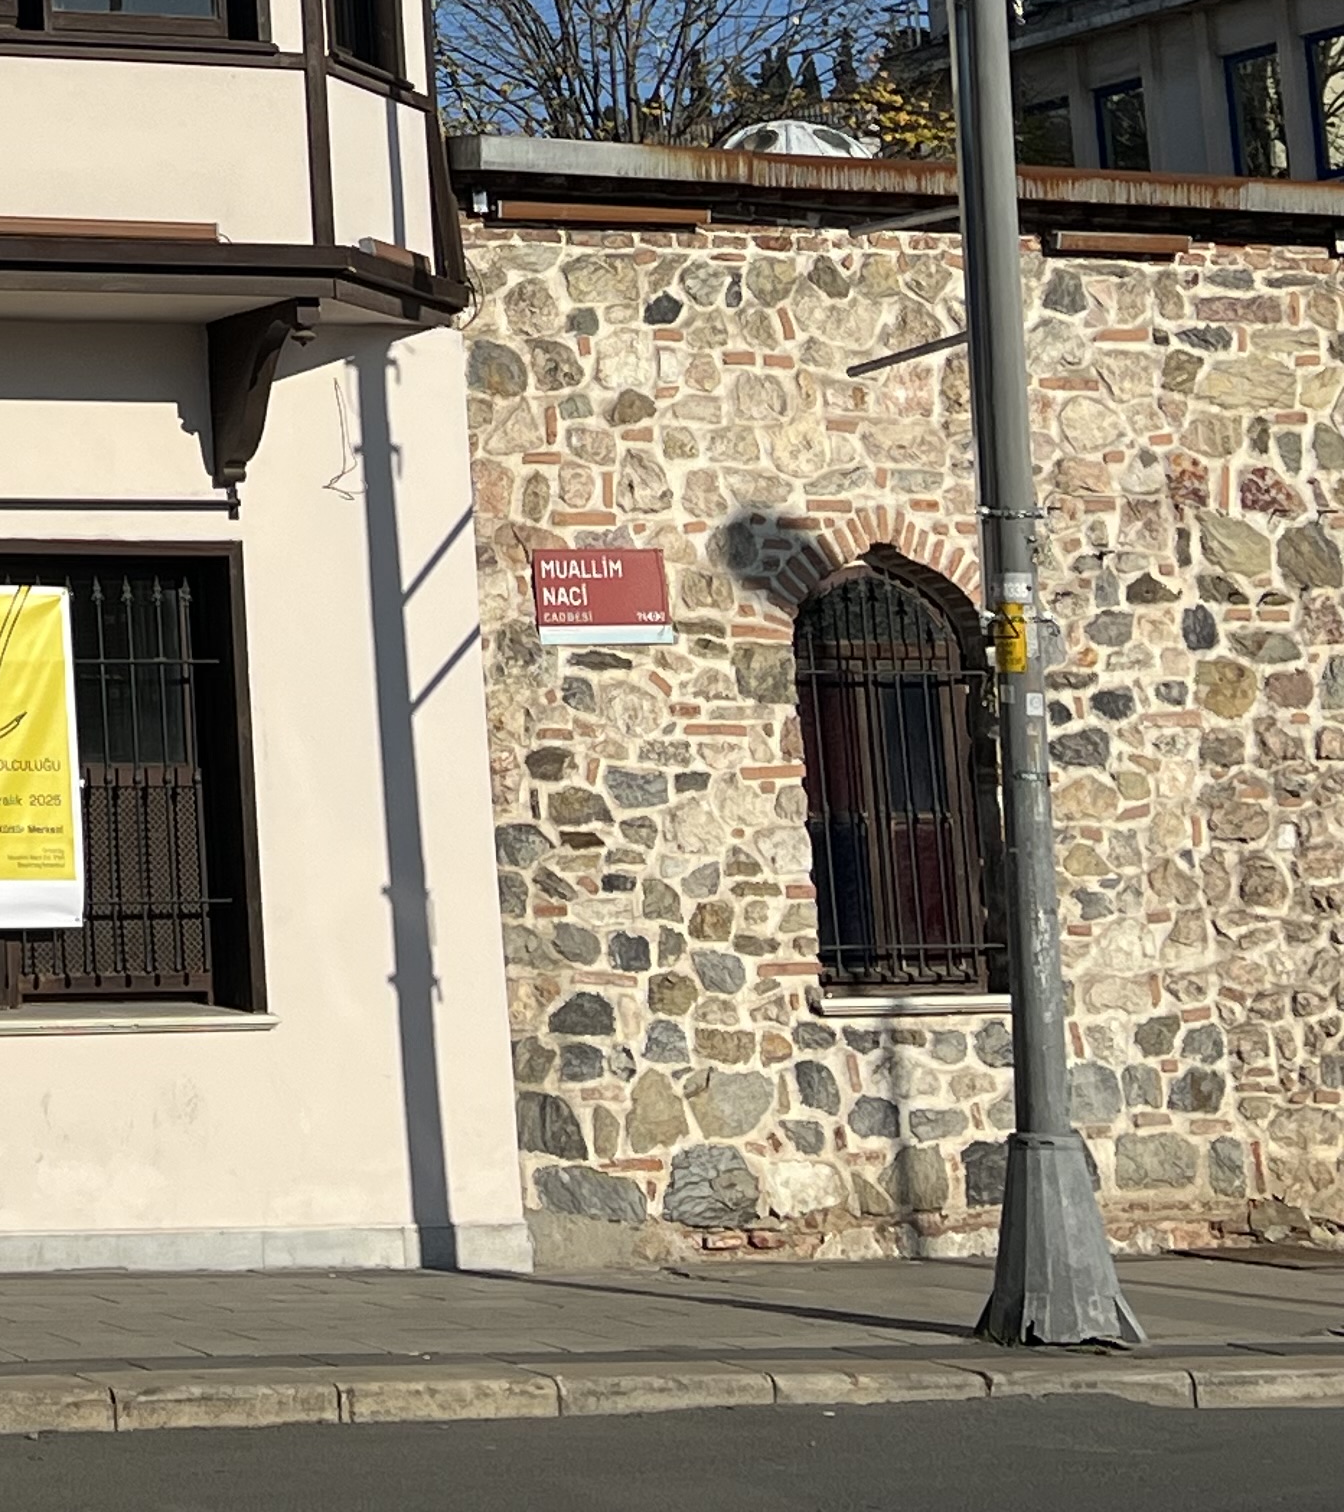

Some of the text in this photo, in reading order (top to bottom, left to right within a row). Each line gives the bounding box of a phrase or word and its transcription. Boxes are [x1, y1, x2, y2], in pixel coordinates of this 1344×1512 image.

[540, 555, 623, 579] MUALLİM
[542, 583, 588, 606] NACİ
[29, 794, 62, 806] 2025
